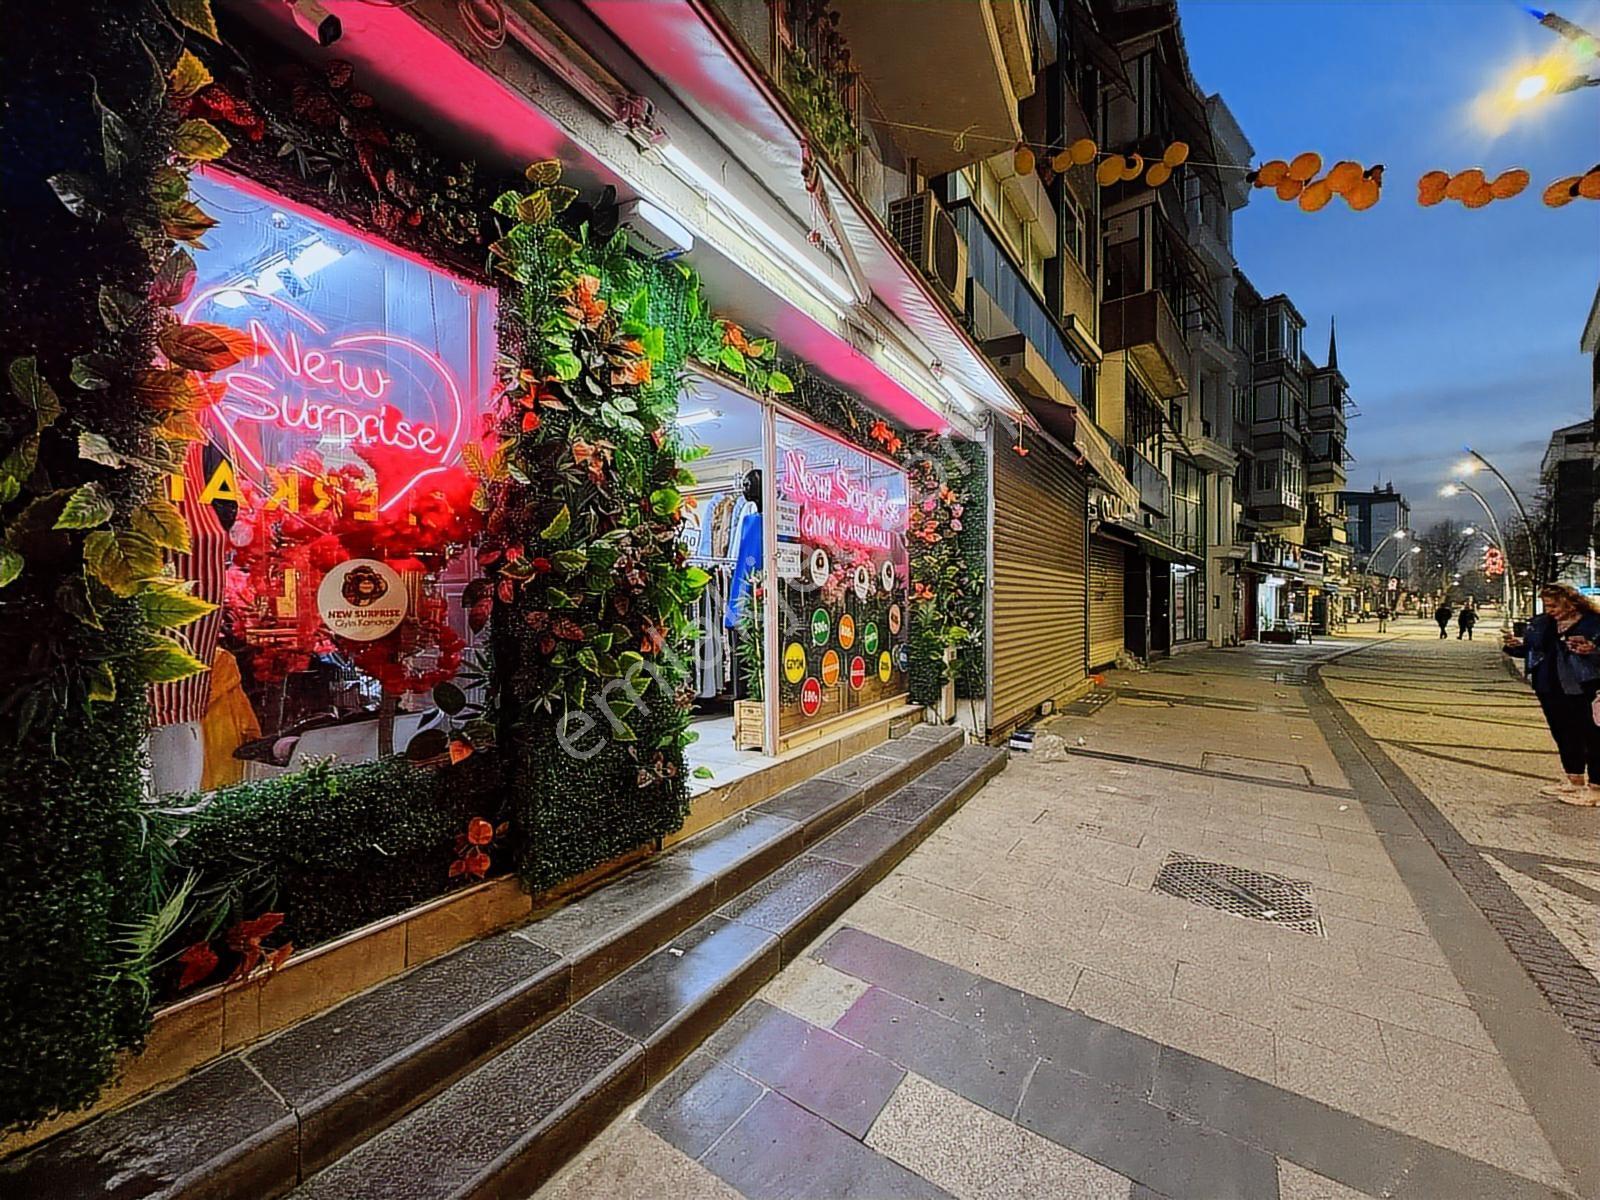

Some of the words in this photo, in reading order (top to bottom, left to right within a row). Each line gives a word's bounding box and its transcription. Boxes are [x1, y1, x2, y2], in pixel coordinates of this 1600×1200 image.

[249, 318, 392, 399] New
[225, 371, 443, 452] Surprise
[782, 450, 832, 502] New
[328, 610, 353, 619] NEW
[354, 609, 401, 618] SURPRISE
